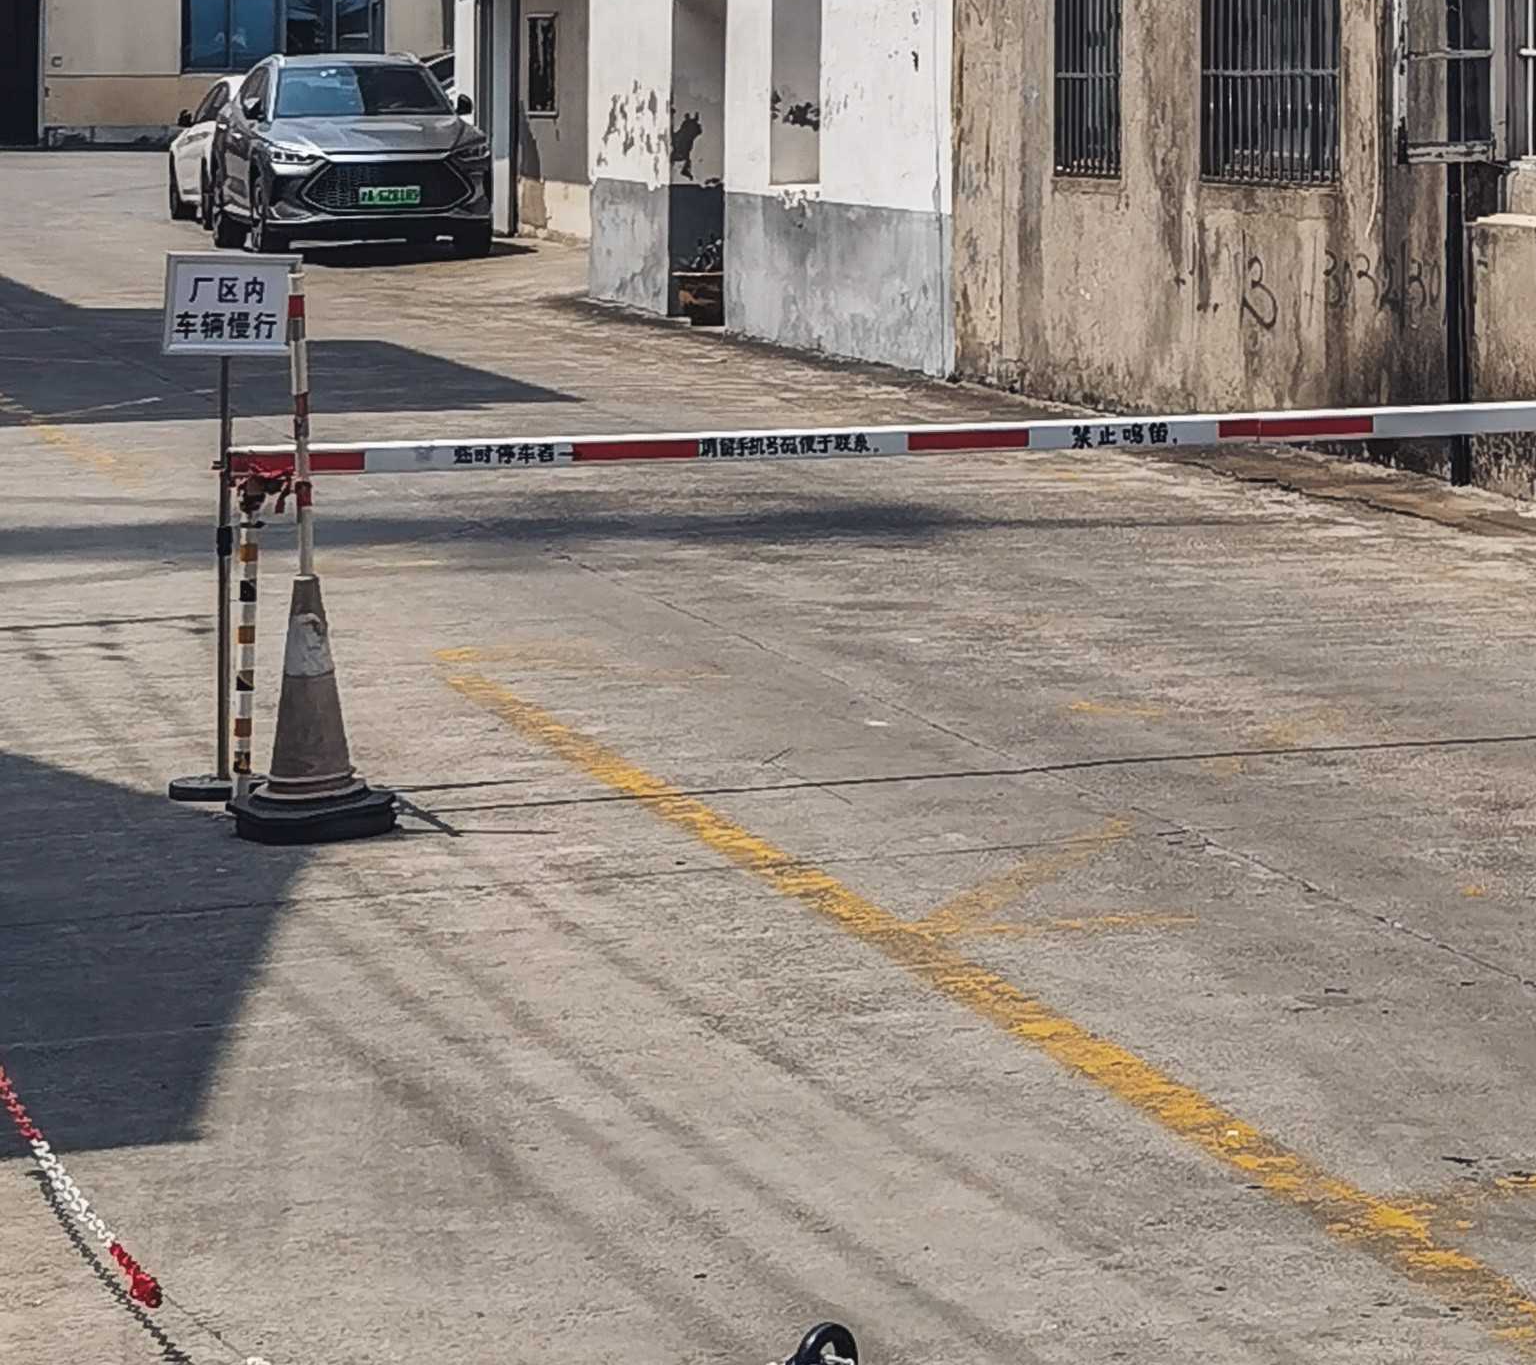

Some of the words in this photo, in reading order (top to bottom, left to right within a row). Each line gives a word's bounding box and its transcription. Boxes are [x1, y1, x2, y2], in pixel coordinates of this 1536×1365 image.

[188, 276, 265, 304] 厂区内
[174, 311, 278, 340] 车辆慢行
